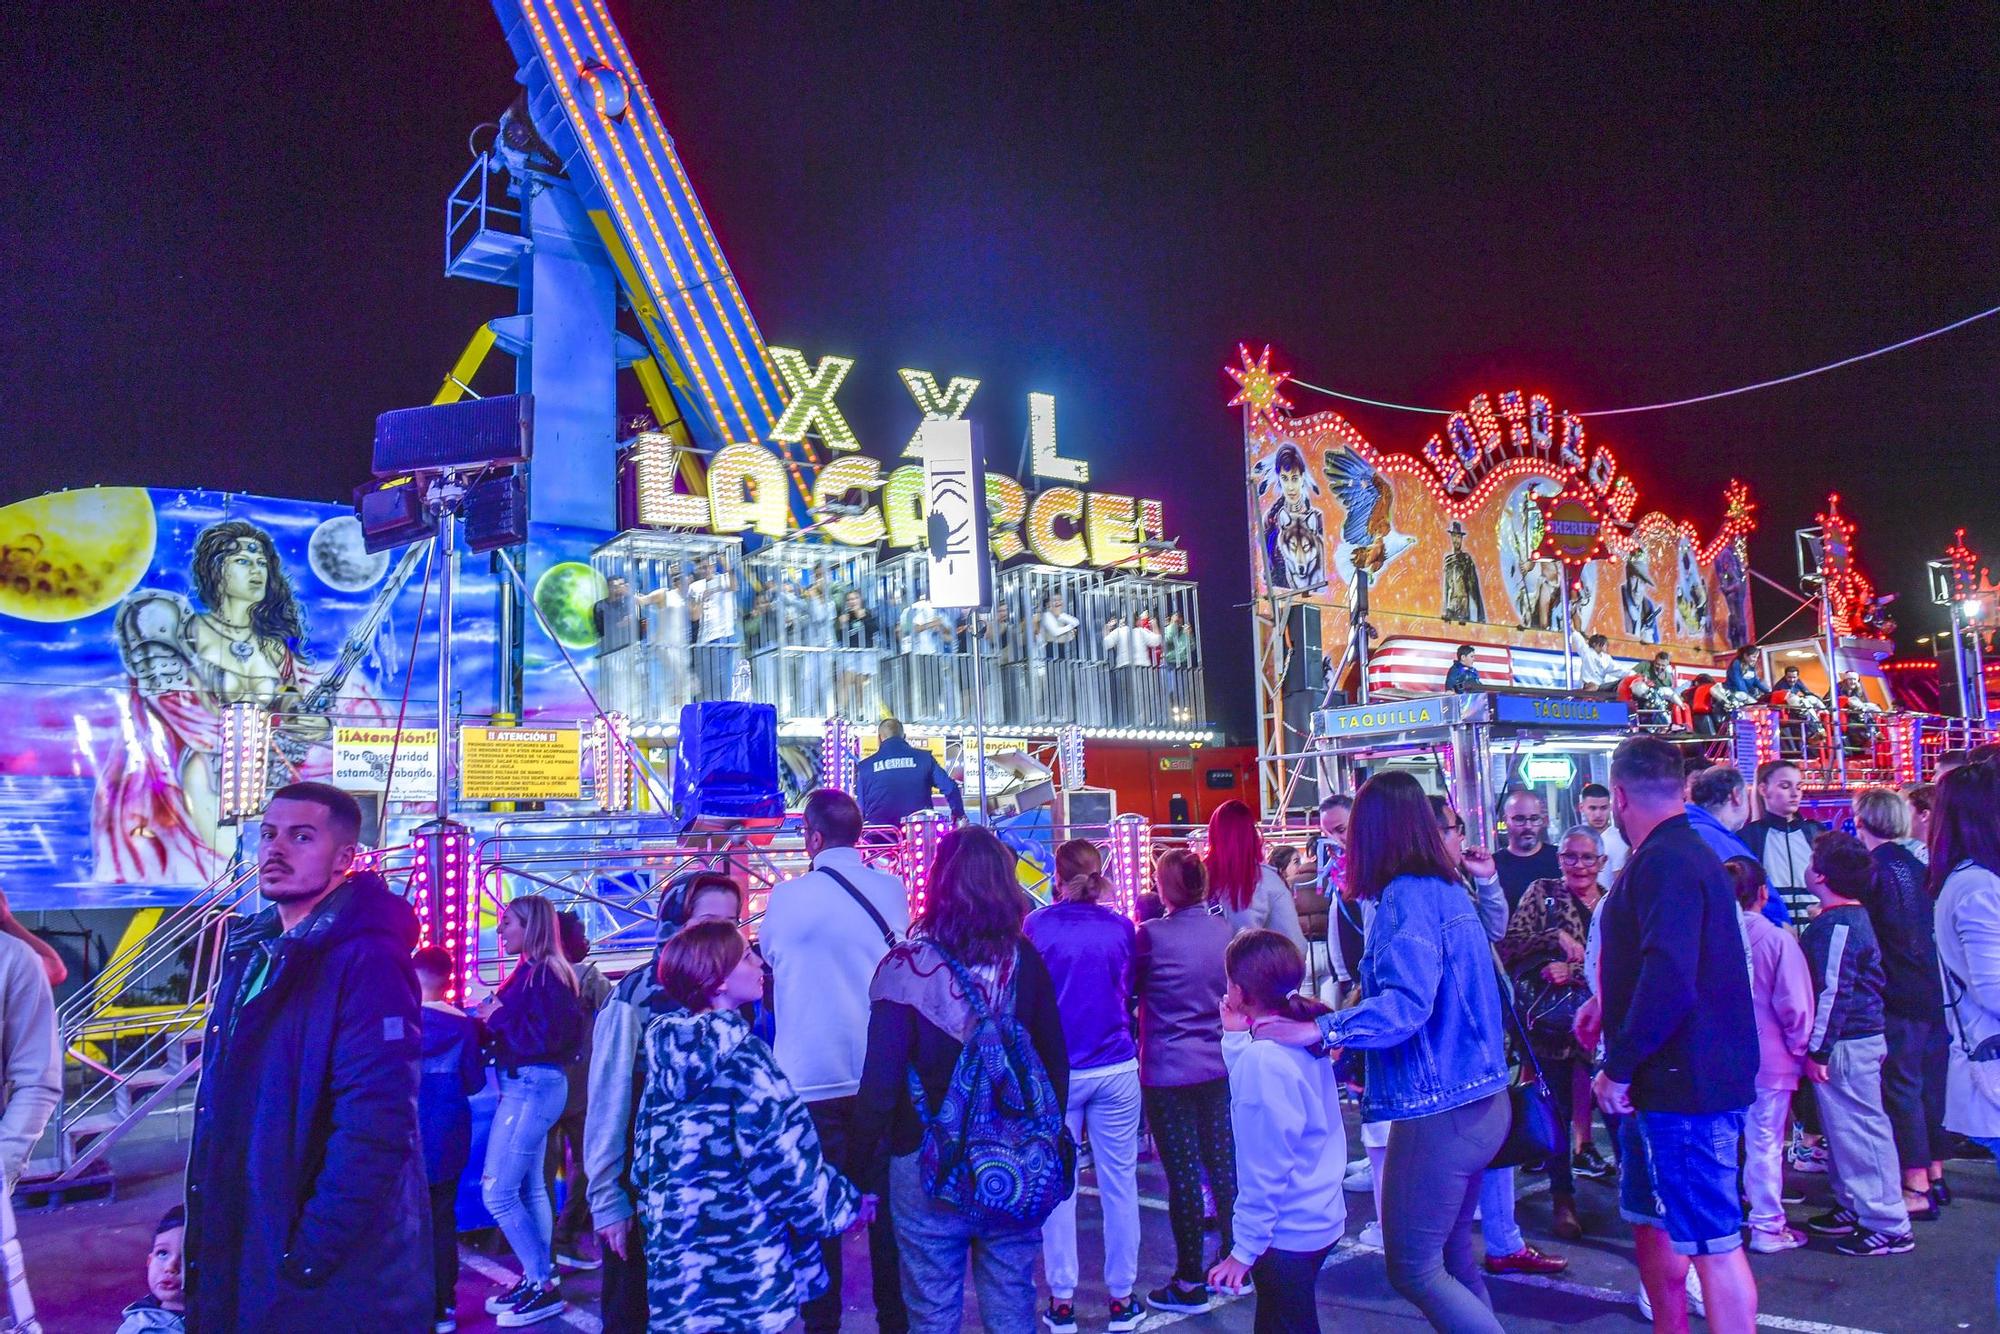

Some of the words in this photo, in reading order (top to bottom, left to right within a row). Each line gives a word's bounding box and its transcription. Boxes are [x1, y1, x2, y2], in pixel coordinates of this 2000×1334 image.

[636, 431, 789, 537] LA
[1338, 707, 1431, 729] TAQUILLA
[1532, 701, 1600, 720] TAQUILLA
[497, 730, 547, 741] ATENCIÓN
